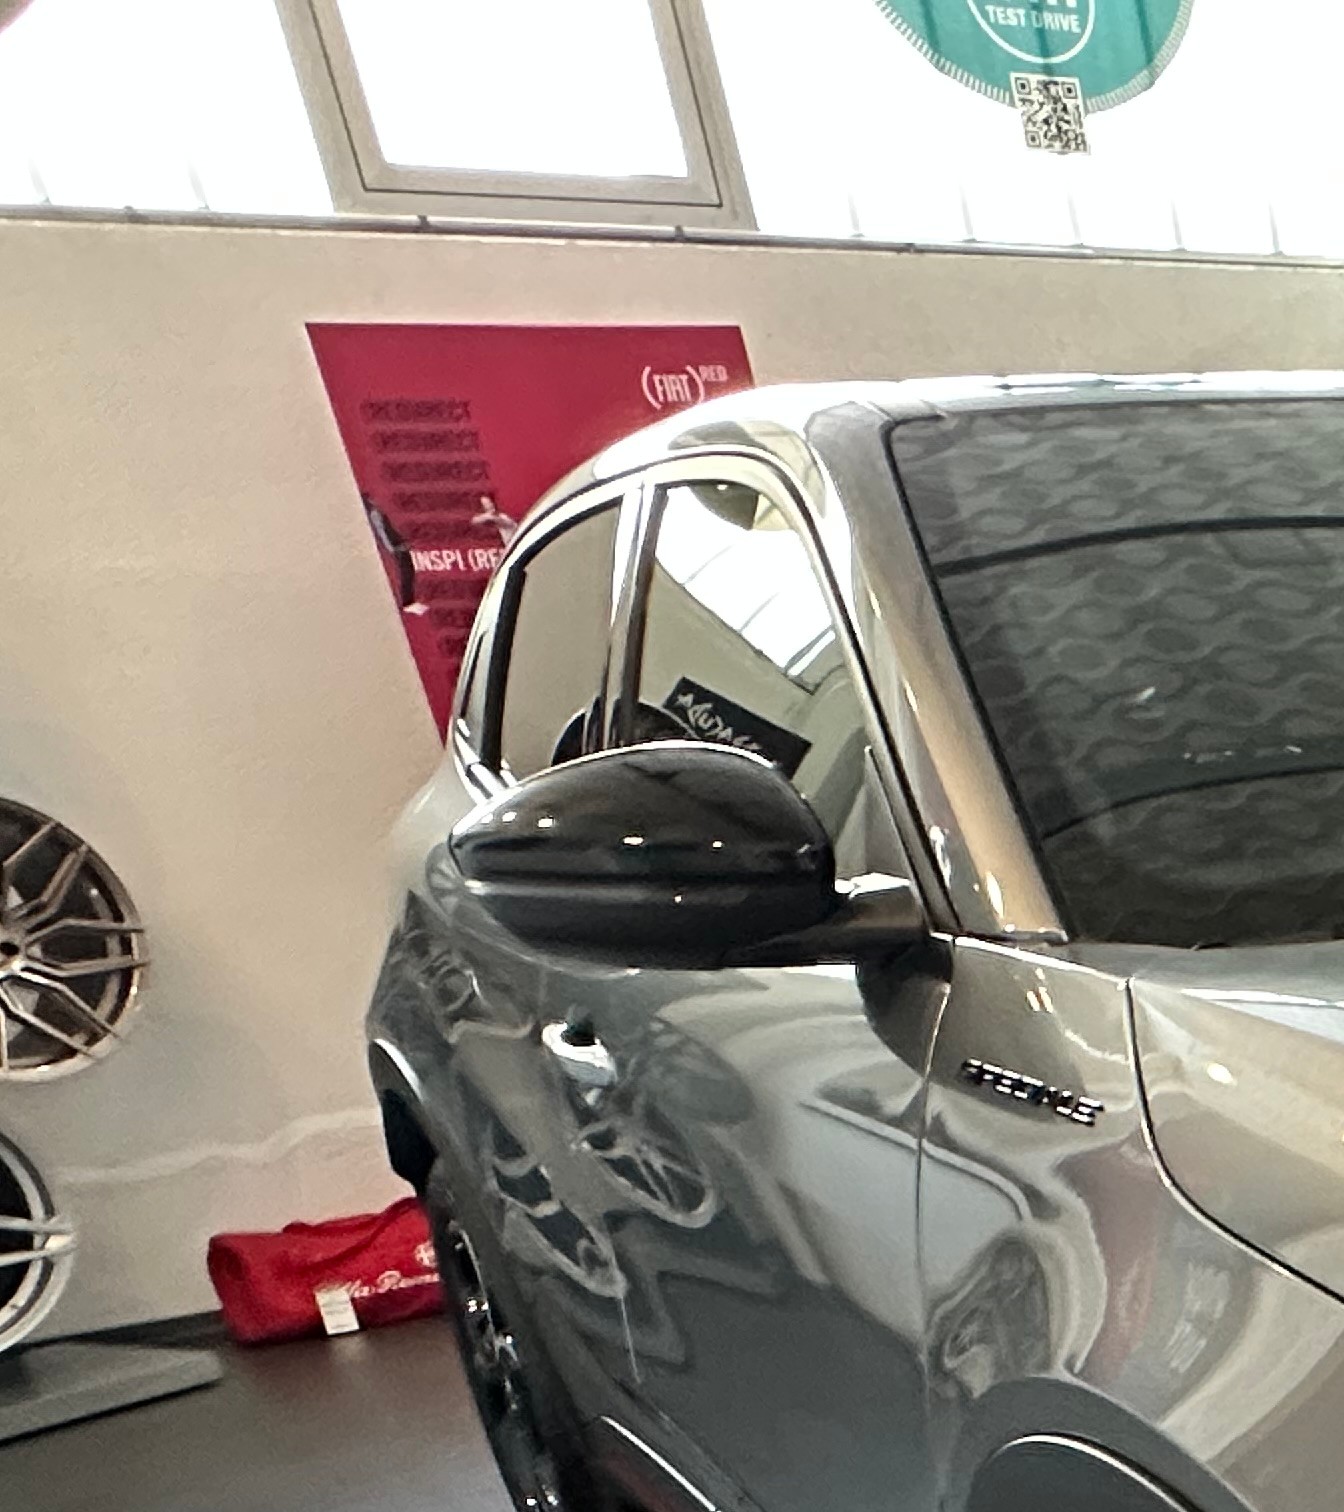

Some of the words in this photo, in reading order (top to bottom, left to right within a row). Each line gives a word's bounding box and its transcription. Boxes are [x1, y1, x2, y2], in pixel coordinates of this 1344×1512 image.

[985, 4, 1025, 28] TEST
[1030, 10, 1081, 34] DRIVE
[467, 548, 504, 571] (RE
